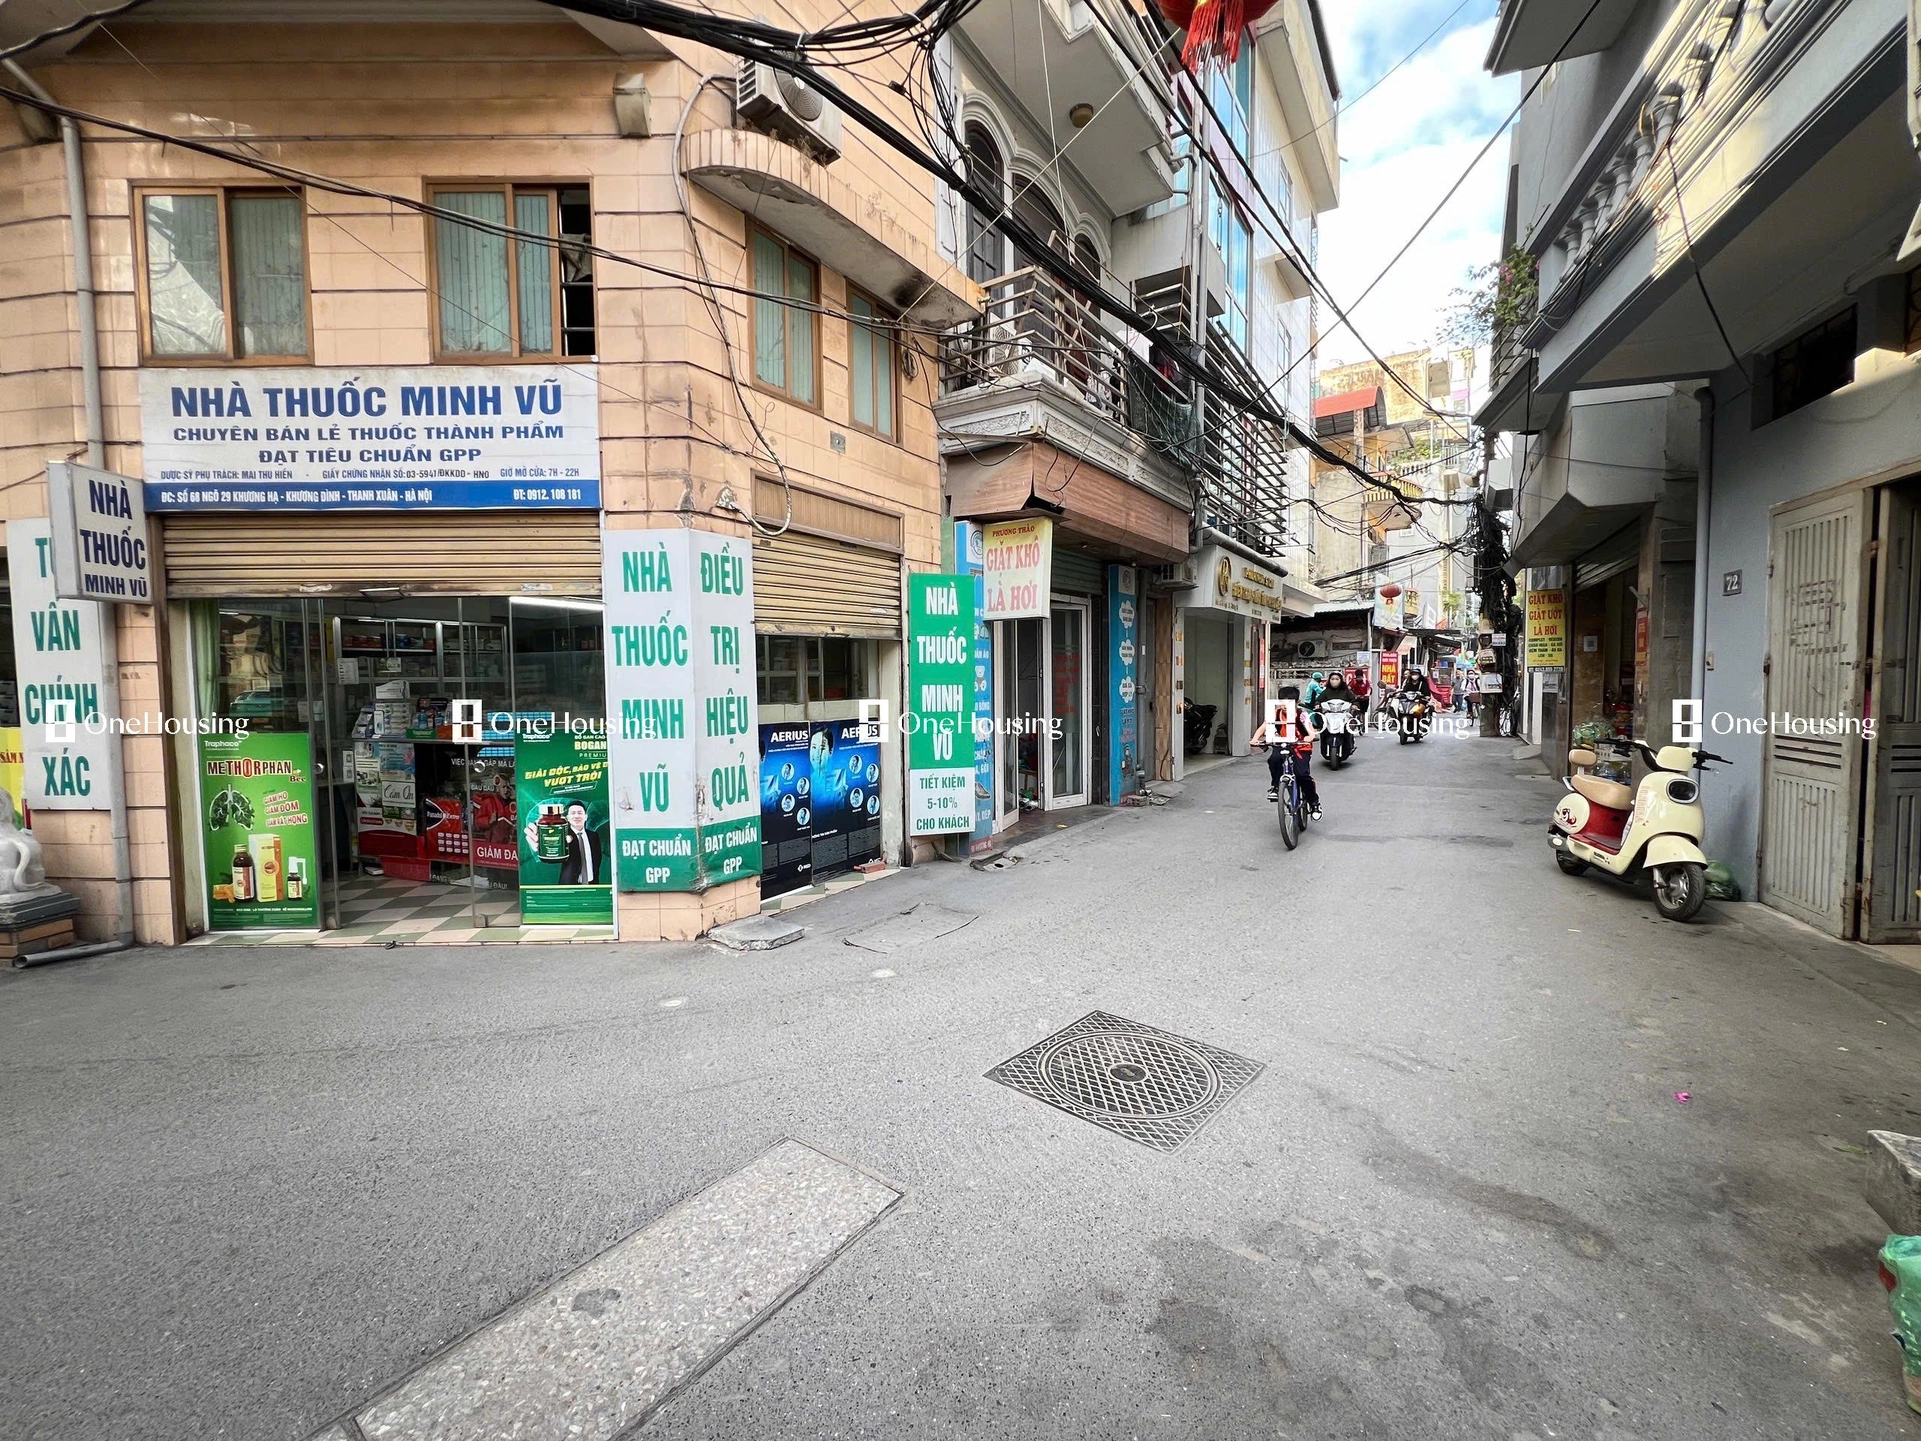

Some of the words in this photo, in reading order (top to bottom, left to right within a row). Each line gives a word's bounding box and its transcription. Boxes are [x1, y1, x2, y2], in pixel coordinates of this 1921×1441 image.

[171, 381, 252, 417] NHÀ
[262, 376, 387, 418] THUỐC
[400, 385, 501, 416] MINH
[514, 378, 562, 416] VŨ
[173, 426, 258, 441] CHUYÊN
[266, 425, 310, 441] BÁN
[317, 424, 340, 441] LẺ
[348, 422, 417, 440] THUỐC
[424, 424, 494, 440] THÀNH
[502, 420, 563, 439] PHẨM
[259, 450, 299, 465] ĐẠT
[306, 447, 351, 463] TIÊU
[359, 444, 432, 462] CHUẨN
[439, 449, 482, 462] GPP
[195, 470, 211, 481] PHỤ
[241, 470, 256, 480] MAI
[258, 470, 273, 480] THU
[322, 467, 340, 479] GIẤY
[370, 468, 391, 480] NHẬN
[500, 467, 513, 478] GIỜ
[548, 468, 558, 477] 7H
[565, 467, 580, 477] 22H
[89, 479, 133, 520] NHÀ
[177, 488, 189, 503] SỐ
[190, 491, 200, 503] 68
[202, 489, 219, 503] NGÕ
[220, 491, 231, 503] 29
[232, 490, 266, 503] KHƯƠNG
[267, 490, 279, 504] HẠ
[286, 490, 319, 503] KHƯƠNG
[320, 488, 340, 502] ĐÌNH
[347, 489, 374, 501] THANH
[375, 488, 398, 502] XUÂN
[404, 488, 417, 501] HÀ
[417, 488, 433, 503] NỘI
[513, 488, 526, 500] ĐT:
[527, 488, 549, 500] 0912.
[550, 488, 565, 500] 108
[567, 488, 581, 500] 181
[992, 528, 1017, 538] PHƯƠNG
[1018, 524, 1035, 535] THẢO
[79, 526, 147, 570] THUỐC
[986, 540, 1013, 577] GIẶT
[1015, 535, 1041, 569] KHÔ
[622, 541, 673, 592] NHÀ
[700, 541, 744, 596] ĐIỀU
[85, 573, 126, 595] MINH
[129, 576, 148, 597] VŨ
[987, 580, 1006, 612] LÀ
[1010, 579, 1038, 610] HƠI
[1726, 574, 1739, 591] 72
[925, 583, 959, 616] NHÀ
[611, 610, 688, 667] THUỐC
[710, 625, 740, 674] TRỊ
[917, 626, 967, 665] THUỐC
[25, 674, 99, 725] CHÍNH
[921, 684, 963, 713] MINH
[621, 699, 685, 740] MINH
[705, 688, 749, 744] HIỆU
[203, 740, 239, 748] Traphaco
[574, 741, 607, 750] BOGAN
[770, 730, 809, 743] AERIUS
[932, 726, 953, 761] VŨ
[42, 747, 91, 797] XÁC
[206, 757, 292, 778] METHORPHAN
[711, 752, 750, 812] QUẢ
[919, 773, 940, 790] TIẾT
[942, 773, 966, 792] KIỆM
[639, 763, 669, 813] VŨ
[927, 797, 958, 810] 5-10%
[916, 817, 939, 831] CHO
[940, 812, 970, 829] KHÁCH
[476, 845, 502, 859] GIẢM
[622, 840, 646, 860] ĐẠT
[649, 833, 691, 856] CHUẨN
[704, 834, 724, 856] ĐẠT
[726, 822, 758, 848] CHUẨN
[645, 867, 671, 884] GPP
[723, 856, 743, 875] GPP
